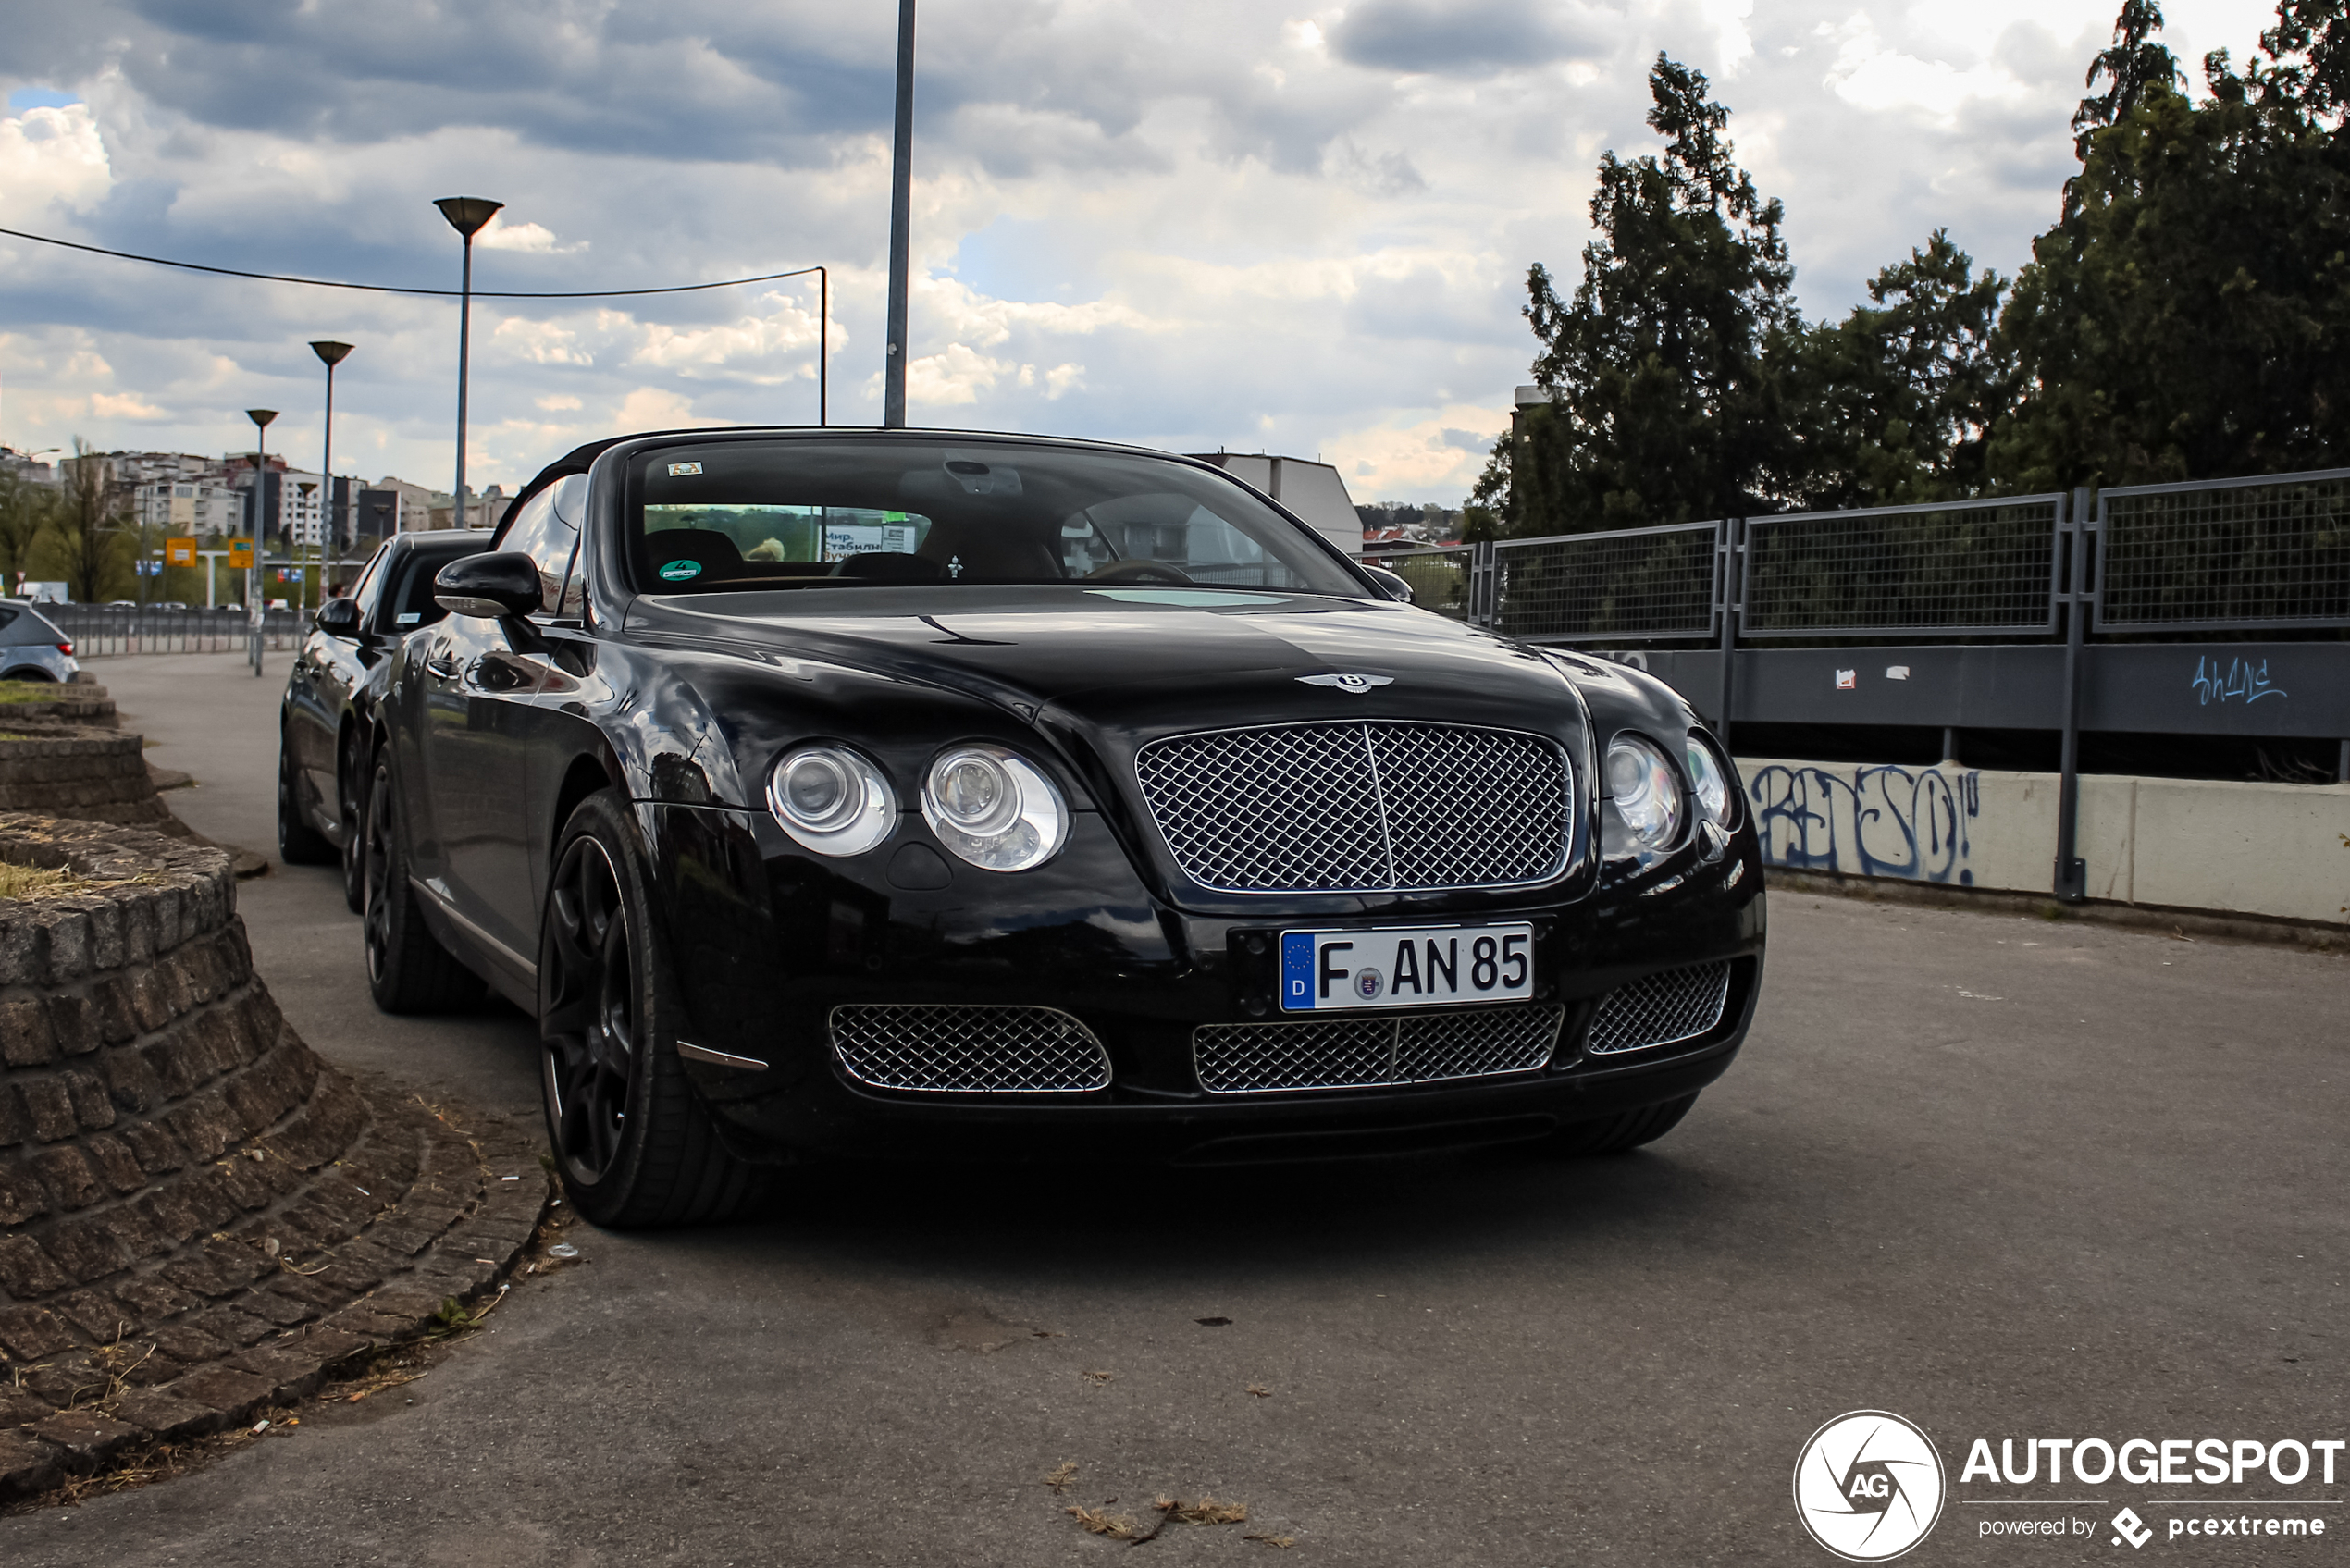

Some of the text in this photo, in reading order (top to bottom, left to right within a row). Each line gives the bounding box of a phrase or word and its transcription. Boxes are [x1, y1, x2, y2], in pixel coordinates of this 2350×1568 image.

[1319, 933, 1528, 998] F AN 85
[1292, 979, 1305, 996] D
